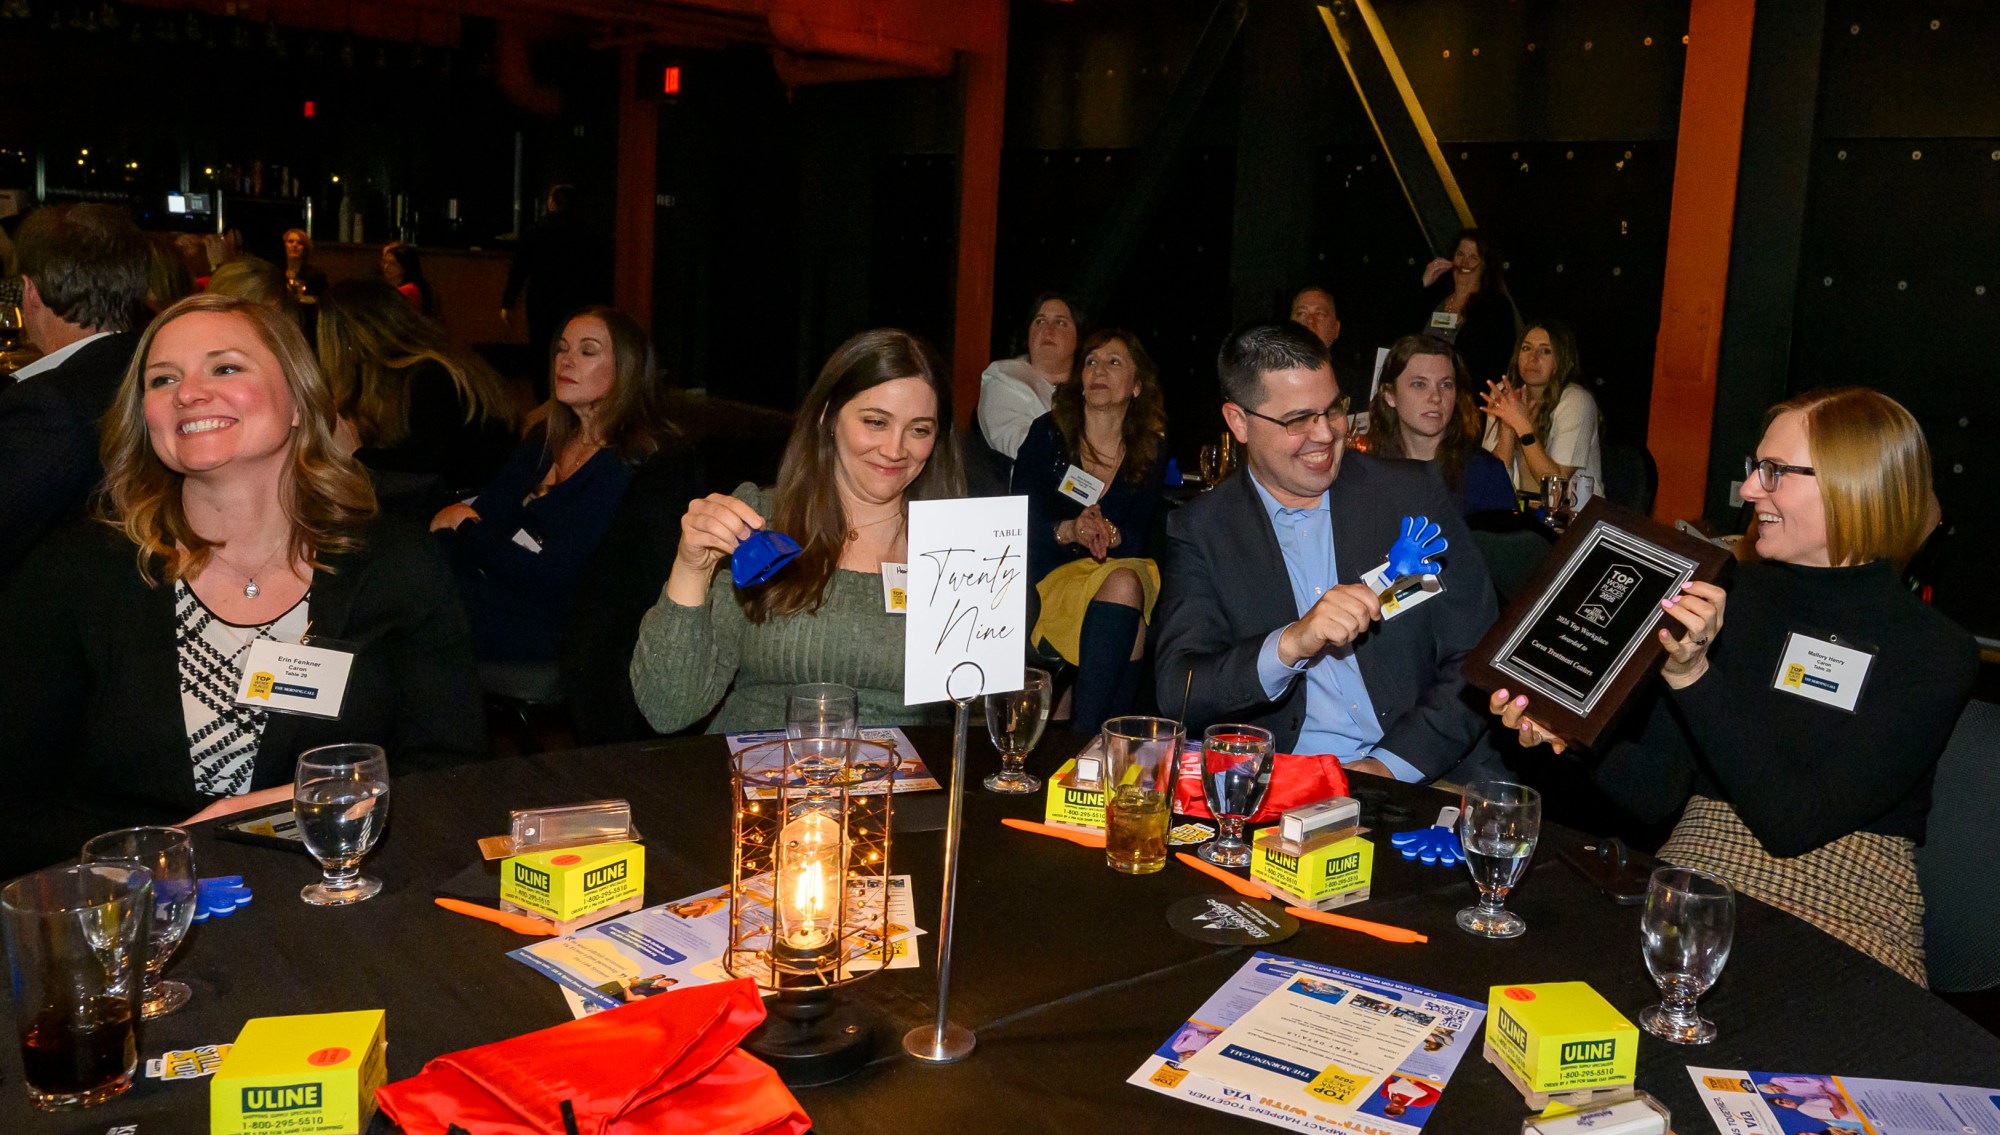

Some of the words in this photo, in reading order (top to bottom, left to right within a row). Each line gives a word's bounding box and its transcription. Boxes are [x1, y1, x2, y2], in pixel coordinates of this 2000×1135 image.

[993, 528, 1023, 538] TABLE
[919, 544, 1021, 610] Twenty
[1607, 578, 1629, 593] WORK
[1611, 571, 1634, 585] TOP
[1601, 584, 1625, 598] PLACES
[935, 599, 1015, 655] Nine
[1556, 615, 1570, 626] 2026
[1570, 621, 1580, 632] Top
[1581, 627, 1609, 646] Workplace
[1559, 634, 1581, 649] Awarded
[294, 659, 321, 667] Fenkner
[1548, 648, 1574, 666] Treatment
[1573, 662, 1594, 677] Centers
[1808, 651, 1828, 661] Mallory
[1829, 657, 1845, 666] Henry
[1068, 790, 1105, 806] ULINE
[1267, 848, 1297, 871] ULINE
[1328, 854, 1358, 874] ULINE
[517, 865, 548, 890] ULINE
[586, 862, 625, 888] ULINE
[1265, 866, 1297, 885] 1-800-295-5510
[584, 884, 628, 905] 1-800-295-5510
[1284, 1030, 1326, 1045] DETAILS
[1500, 1011, 1526, 1049] ULINE
[1229, 1048, 1246, 1058] CALL
[1327, 1043, 1359, 1055] EVENT
[1565, 1042, 1612, 1062] ULINE
[170, 1058, 198, 1076] TOP
[194, 1047, 223, 1073] STILL
[1248, 1055, 1292, 1074] MORNING
[1292, 1068, 1311, 1079] THE
[1560, 1068, 1614, 1080] 1-800-295-5510
[1322, 1082, 1351, 1096] WORK
[1324, 1078, 1356, 1091] PLACES
[247, 1086, 317, 1110] ULINE
[1187, 1089, 1250, 1111] TOGETHER.
[1314, 1088, 1345, 1101] TOP
[1249, 1106, 1301, 1124] HAPPENS
[1259, 1097, 1308, 1117] WITH
[242, 1116, 324, 1130] 1-800-295-5510
